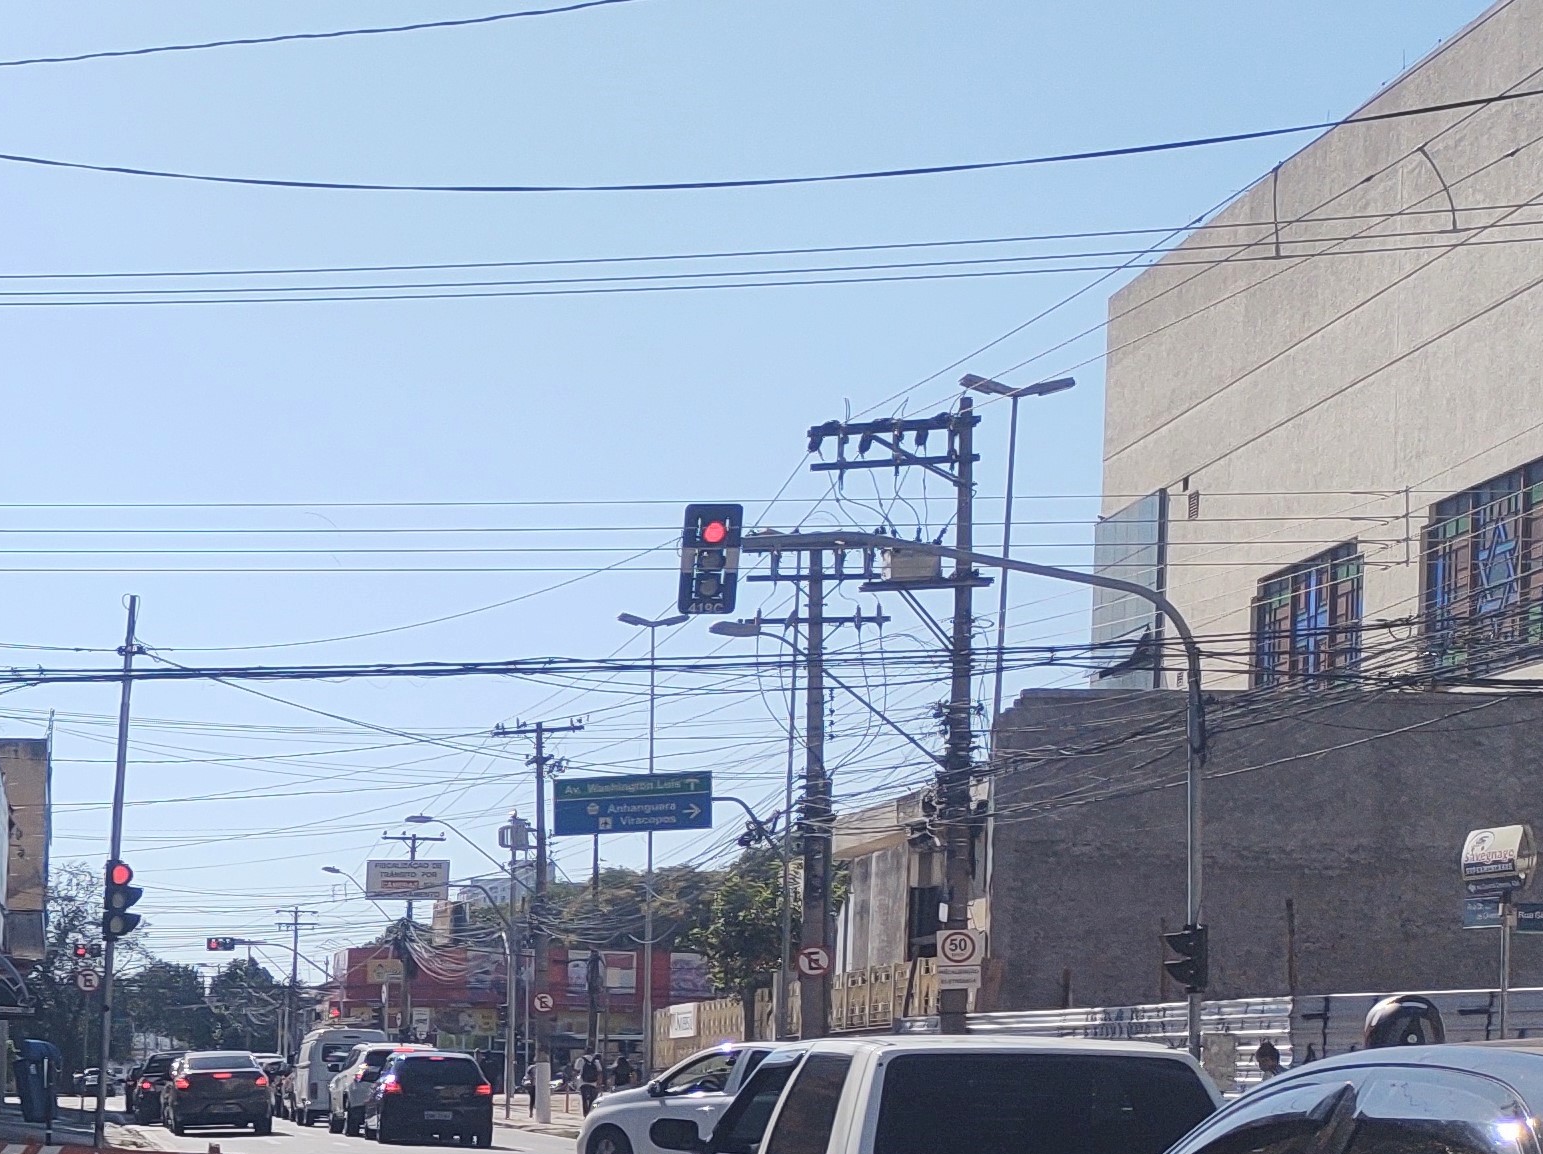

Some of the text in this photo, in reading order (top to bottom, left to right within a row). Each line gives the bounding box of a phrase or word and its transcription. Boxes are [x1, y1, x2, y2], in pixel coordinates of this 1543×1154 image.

[687, 602, 725, 613] 419C
[586, 781, 654, 794] Washington
[607, 802, 676, 814] Anhanguera
[619, 814, 676, 826] Viracopos
[949, 938, 967, 951] 50
